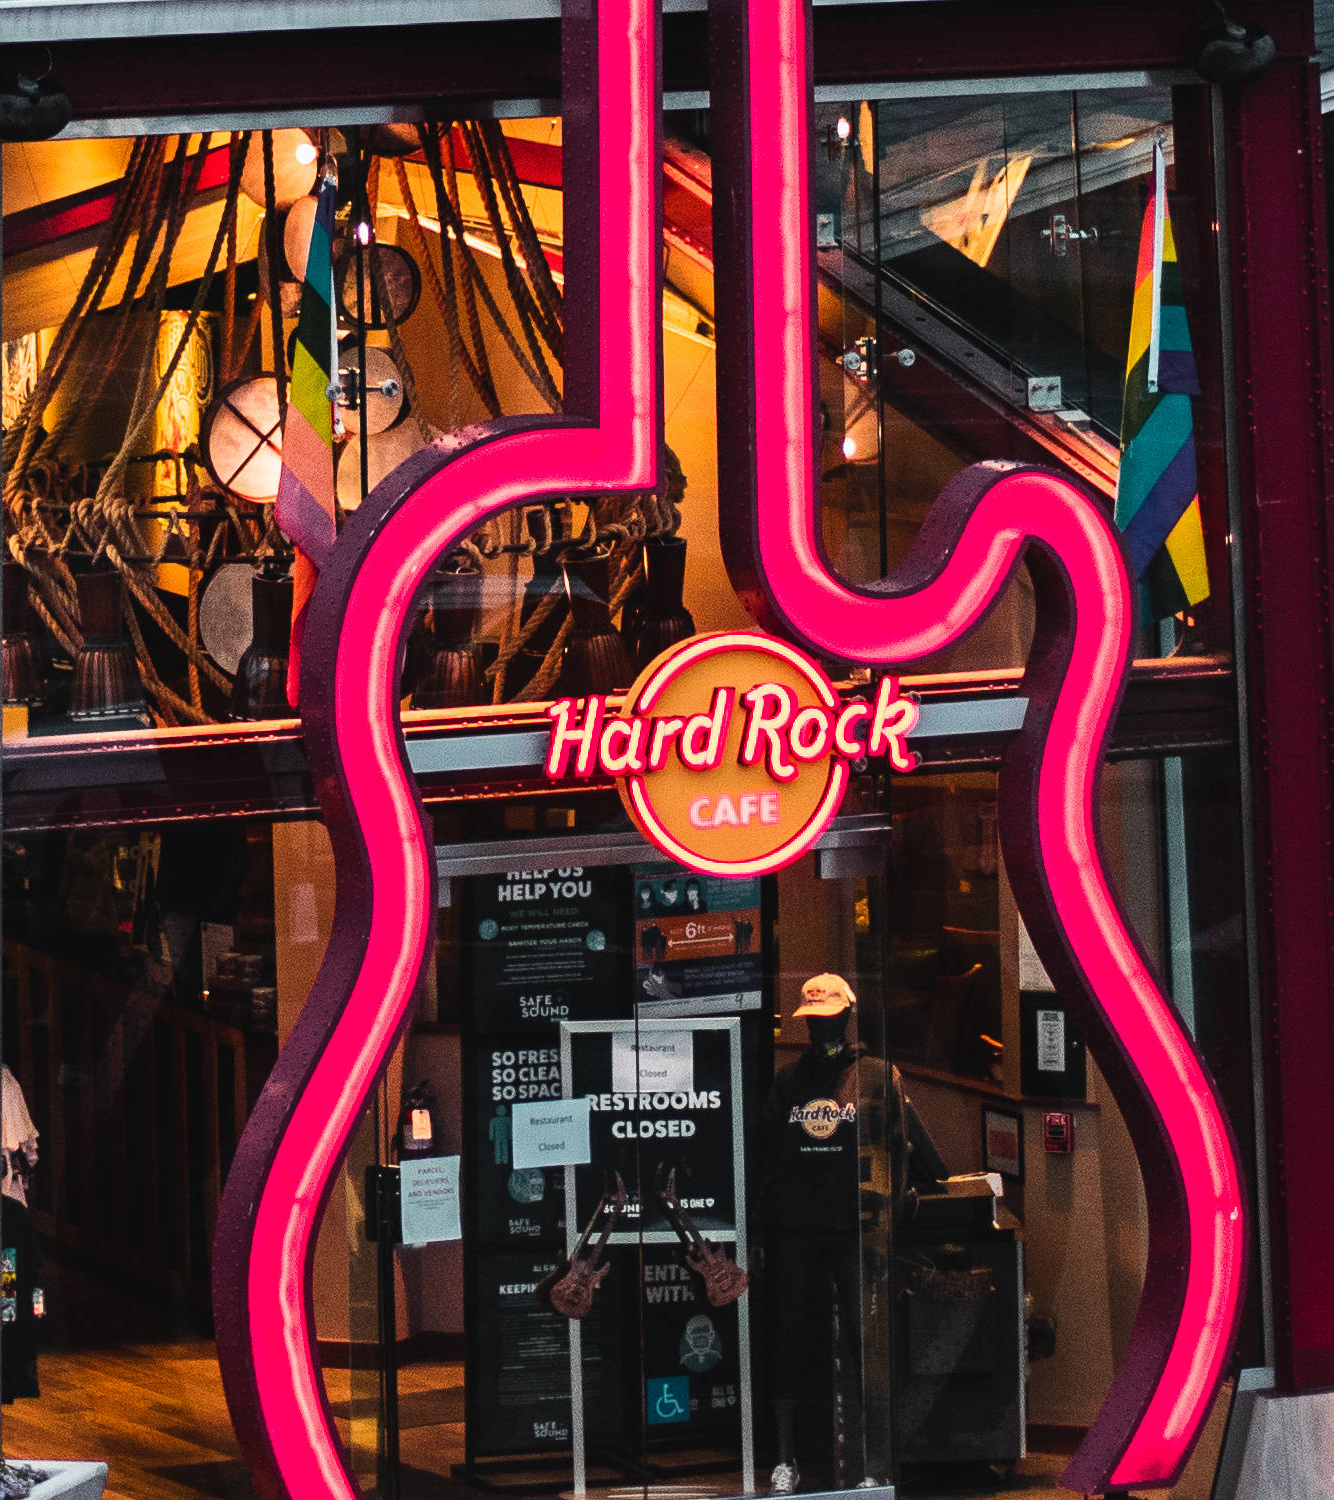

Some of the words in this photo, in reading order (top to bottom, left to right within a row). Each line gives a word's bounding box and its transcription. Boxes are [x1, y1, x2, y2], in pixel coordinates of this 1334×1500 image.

[547, 686, 735, 779] Hard
[740, 675, 923, 783] Rock
[688, 791, 782, 831] CAFE
[498, 883, 547, 902] HELP
[549, 880, 592, 899] YOU
[519, 994, 552, 1008] SAFE
[521, 1004, 570, 1019] SOUND
[491, 1051, 515, 1067] SO
[518, 1049, 560, 1065] FRES
[491, 1067, 515, 1084] SO
[518, 1066, 561, 1082] CLEA
[491, 1085, 515, 1101] SO
[518, 1082, 561, 1099] SPAC
[589, 1091, 721, 1112] RESTROOMS
[530, 1114, 573, 1127] Restaurant
[612, 1119, 696, 1139] CLOSED
[538, 1140, 565, 1152] Closed
[644, 1263, 691, 1283] ENTE
[498, 1282, 540, 1296] KEEPIN
